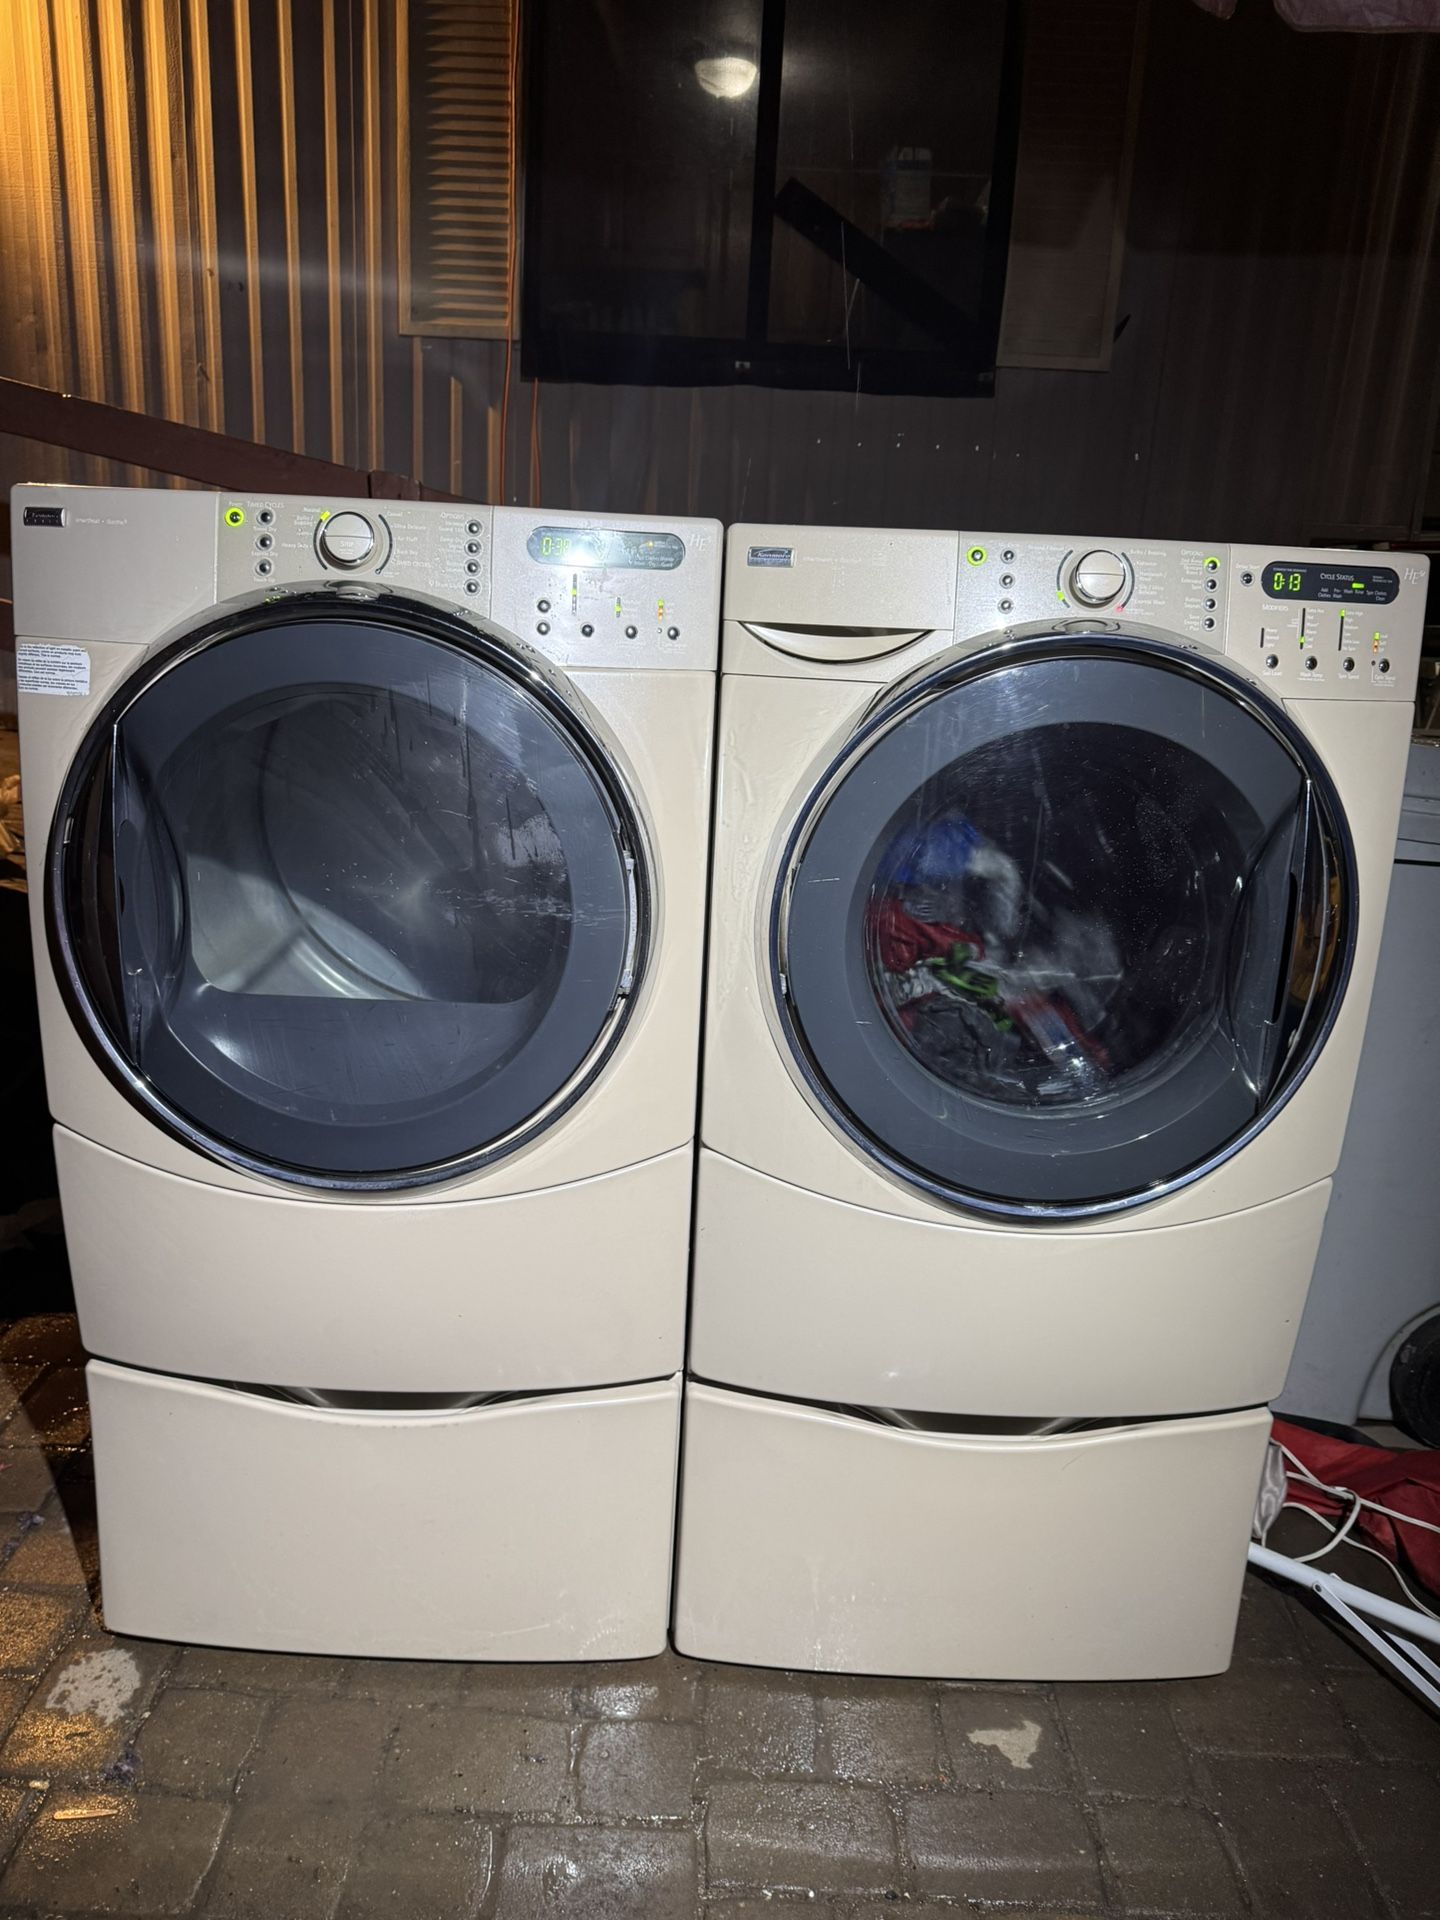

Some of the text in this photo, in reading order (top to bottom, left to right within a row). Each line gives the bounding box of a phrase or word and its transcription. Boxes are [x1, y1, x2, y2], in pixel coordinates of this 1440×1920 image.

[1273, 572, 1301, 591] 0:13
[1320, 572, 1354, 581] CYCLE STATUS
